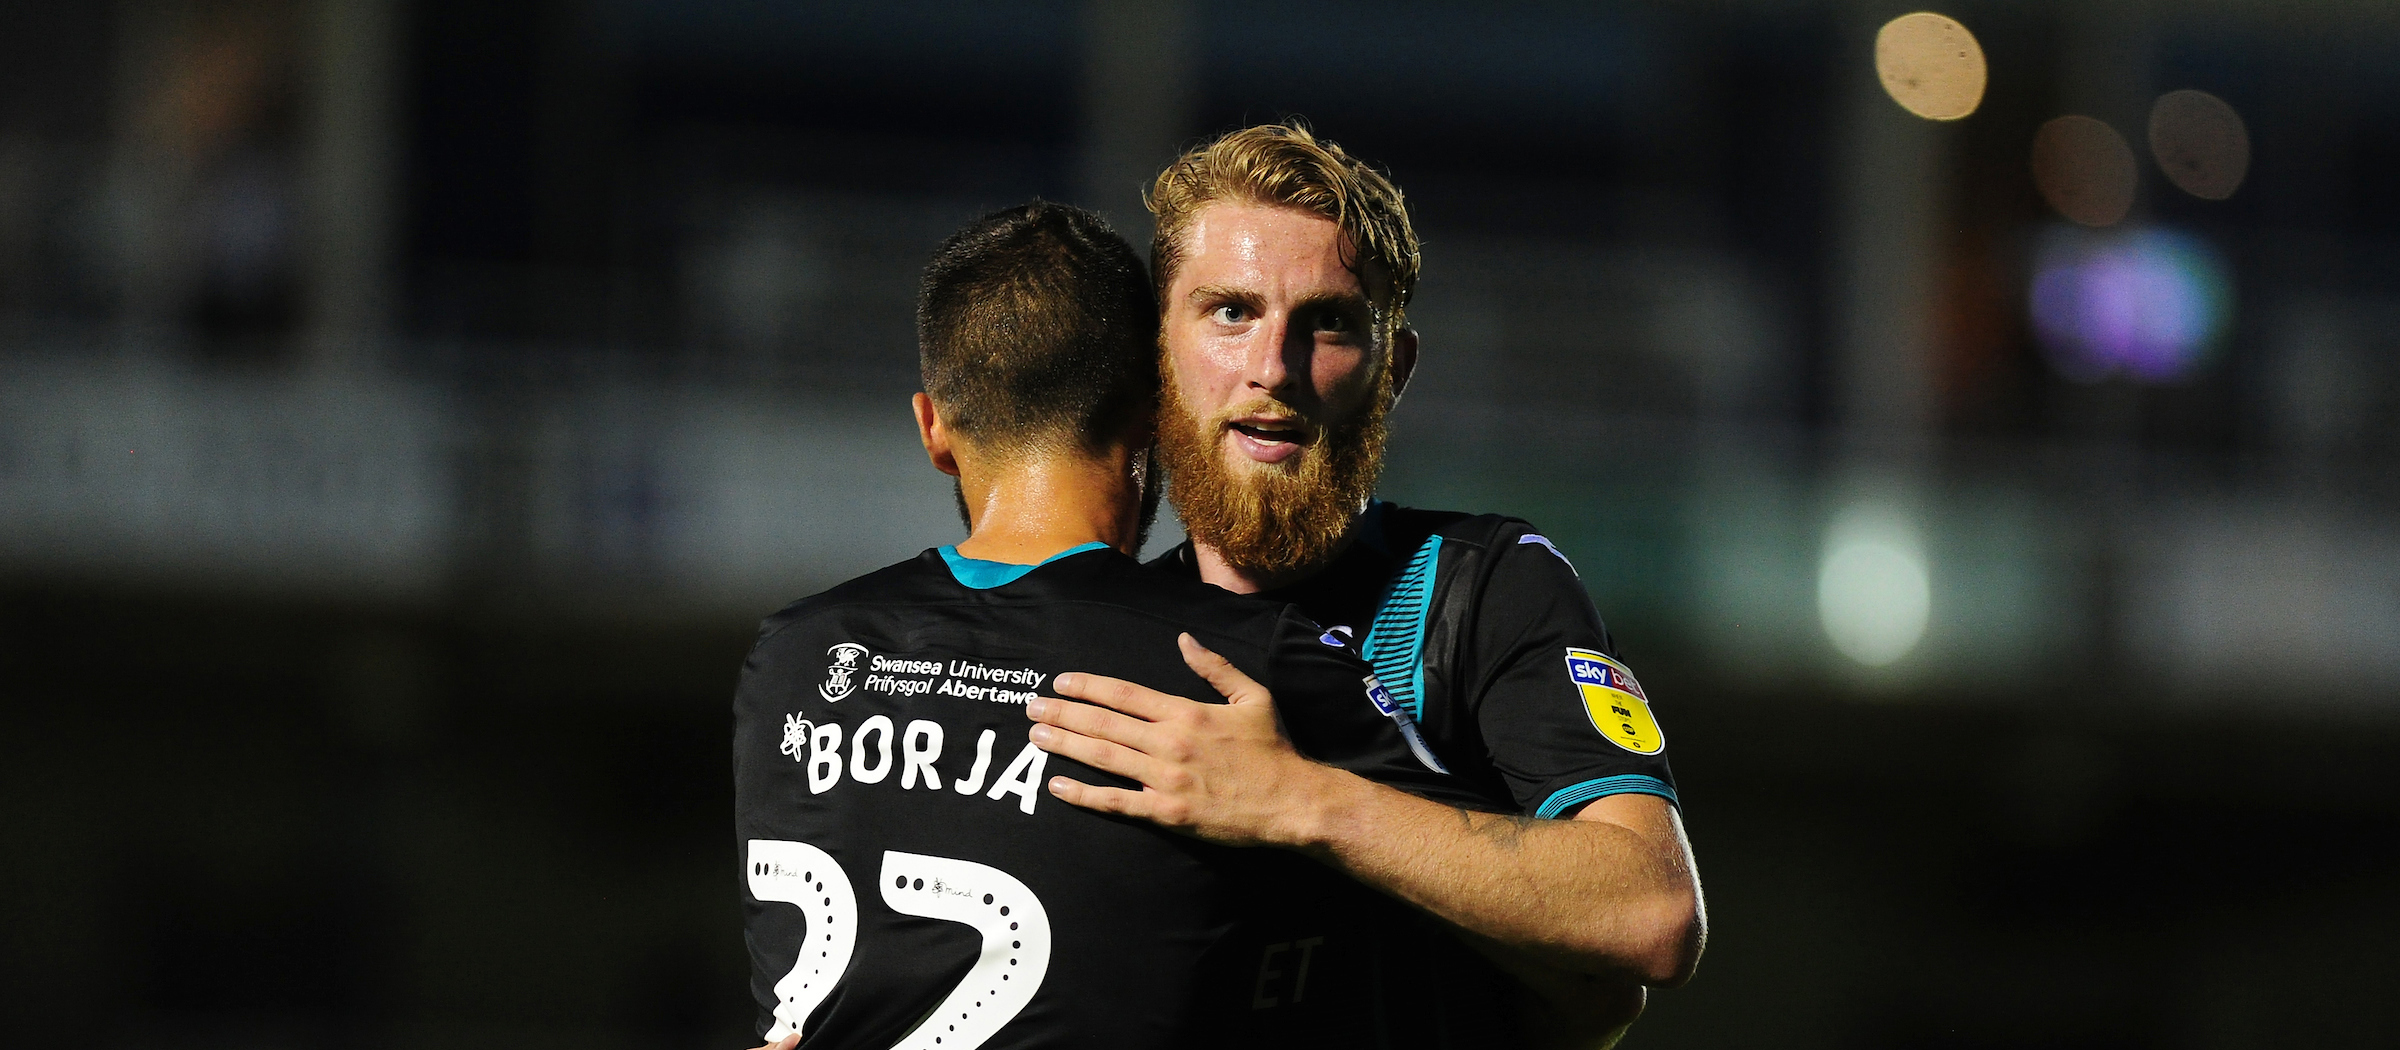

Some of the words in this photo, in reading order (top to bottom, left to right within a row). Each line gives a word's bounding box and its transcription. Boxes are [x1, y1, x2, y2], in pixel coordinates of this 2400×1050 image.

[863, 675, 935, 698] Prifysgol
[869, 655, 943, 677] Swansea
[948, 659, 1047, 689] University
[1575, 662, 1607, 684] sky
[1611, 668, 1640, 694] bet
[807, 714, 1049, 816] BORJA
[945, 883, 974, 899] mind
